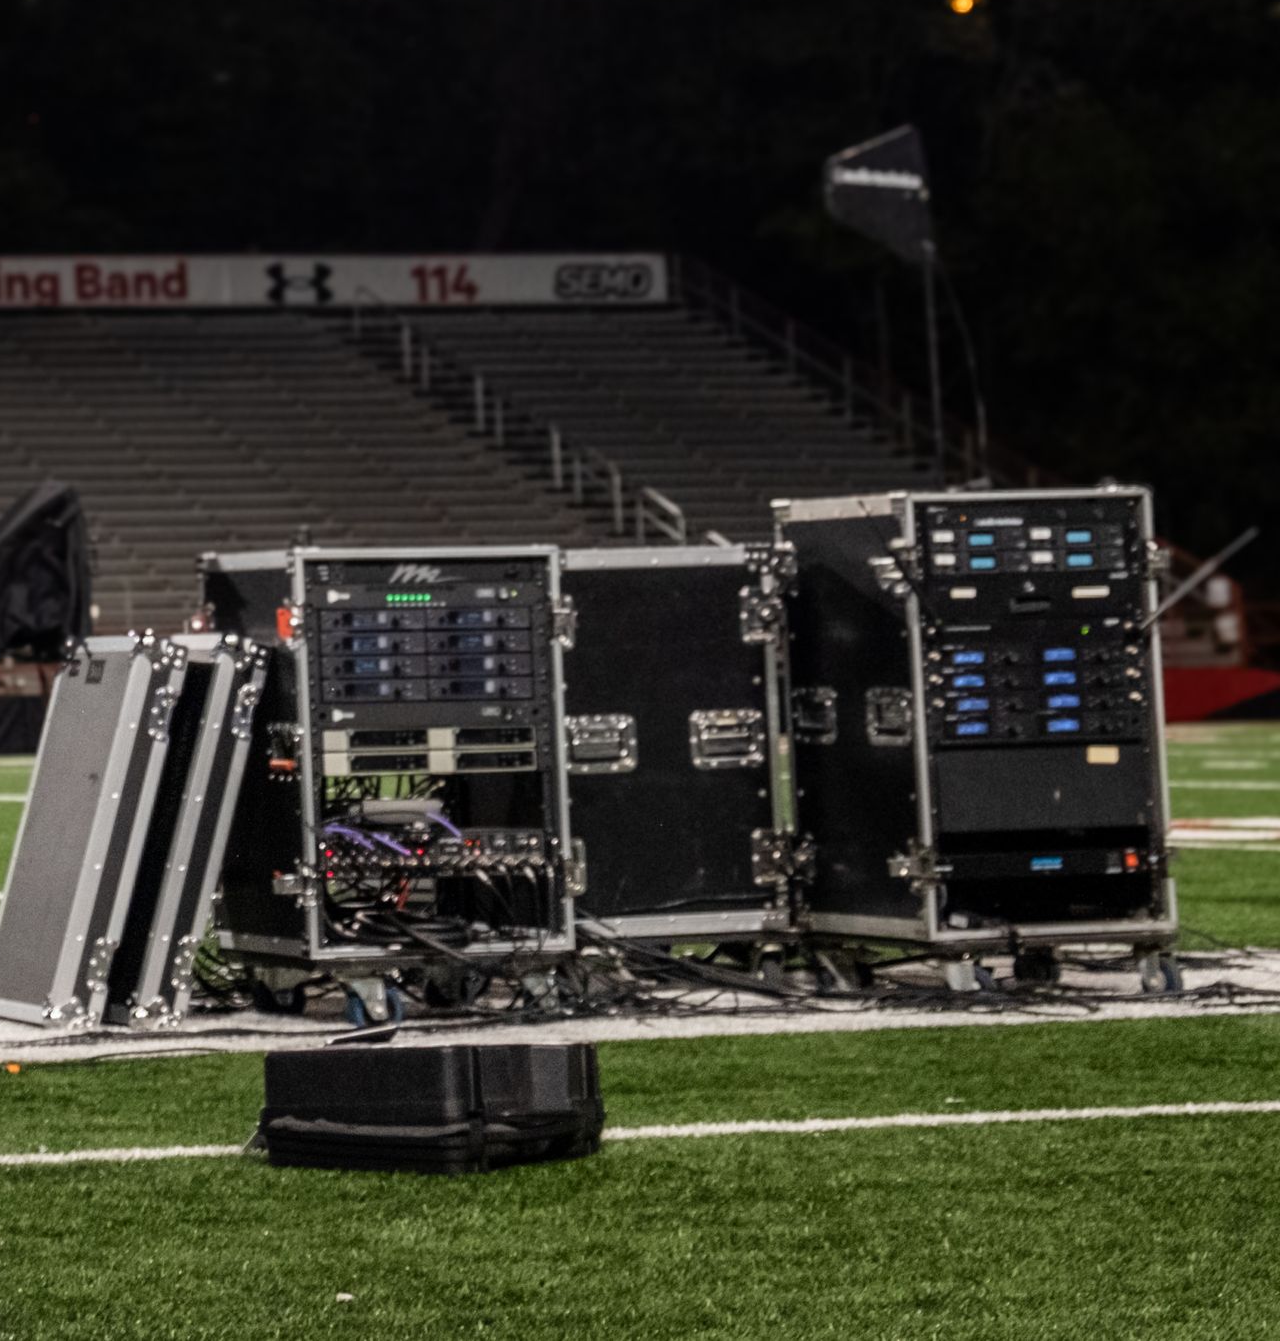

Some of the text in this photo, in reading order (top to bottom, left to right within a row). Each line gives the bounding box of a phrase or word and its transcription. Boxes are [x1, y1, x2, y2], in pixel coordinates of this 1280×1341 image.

[74, 260, 187, 300] Band
[411, 263, 478, 303] 114
[554, 261, 652, 300] SEMO
